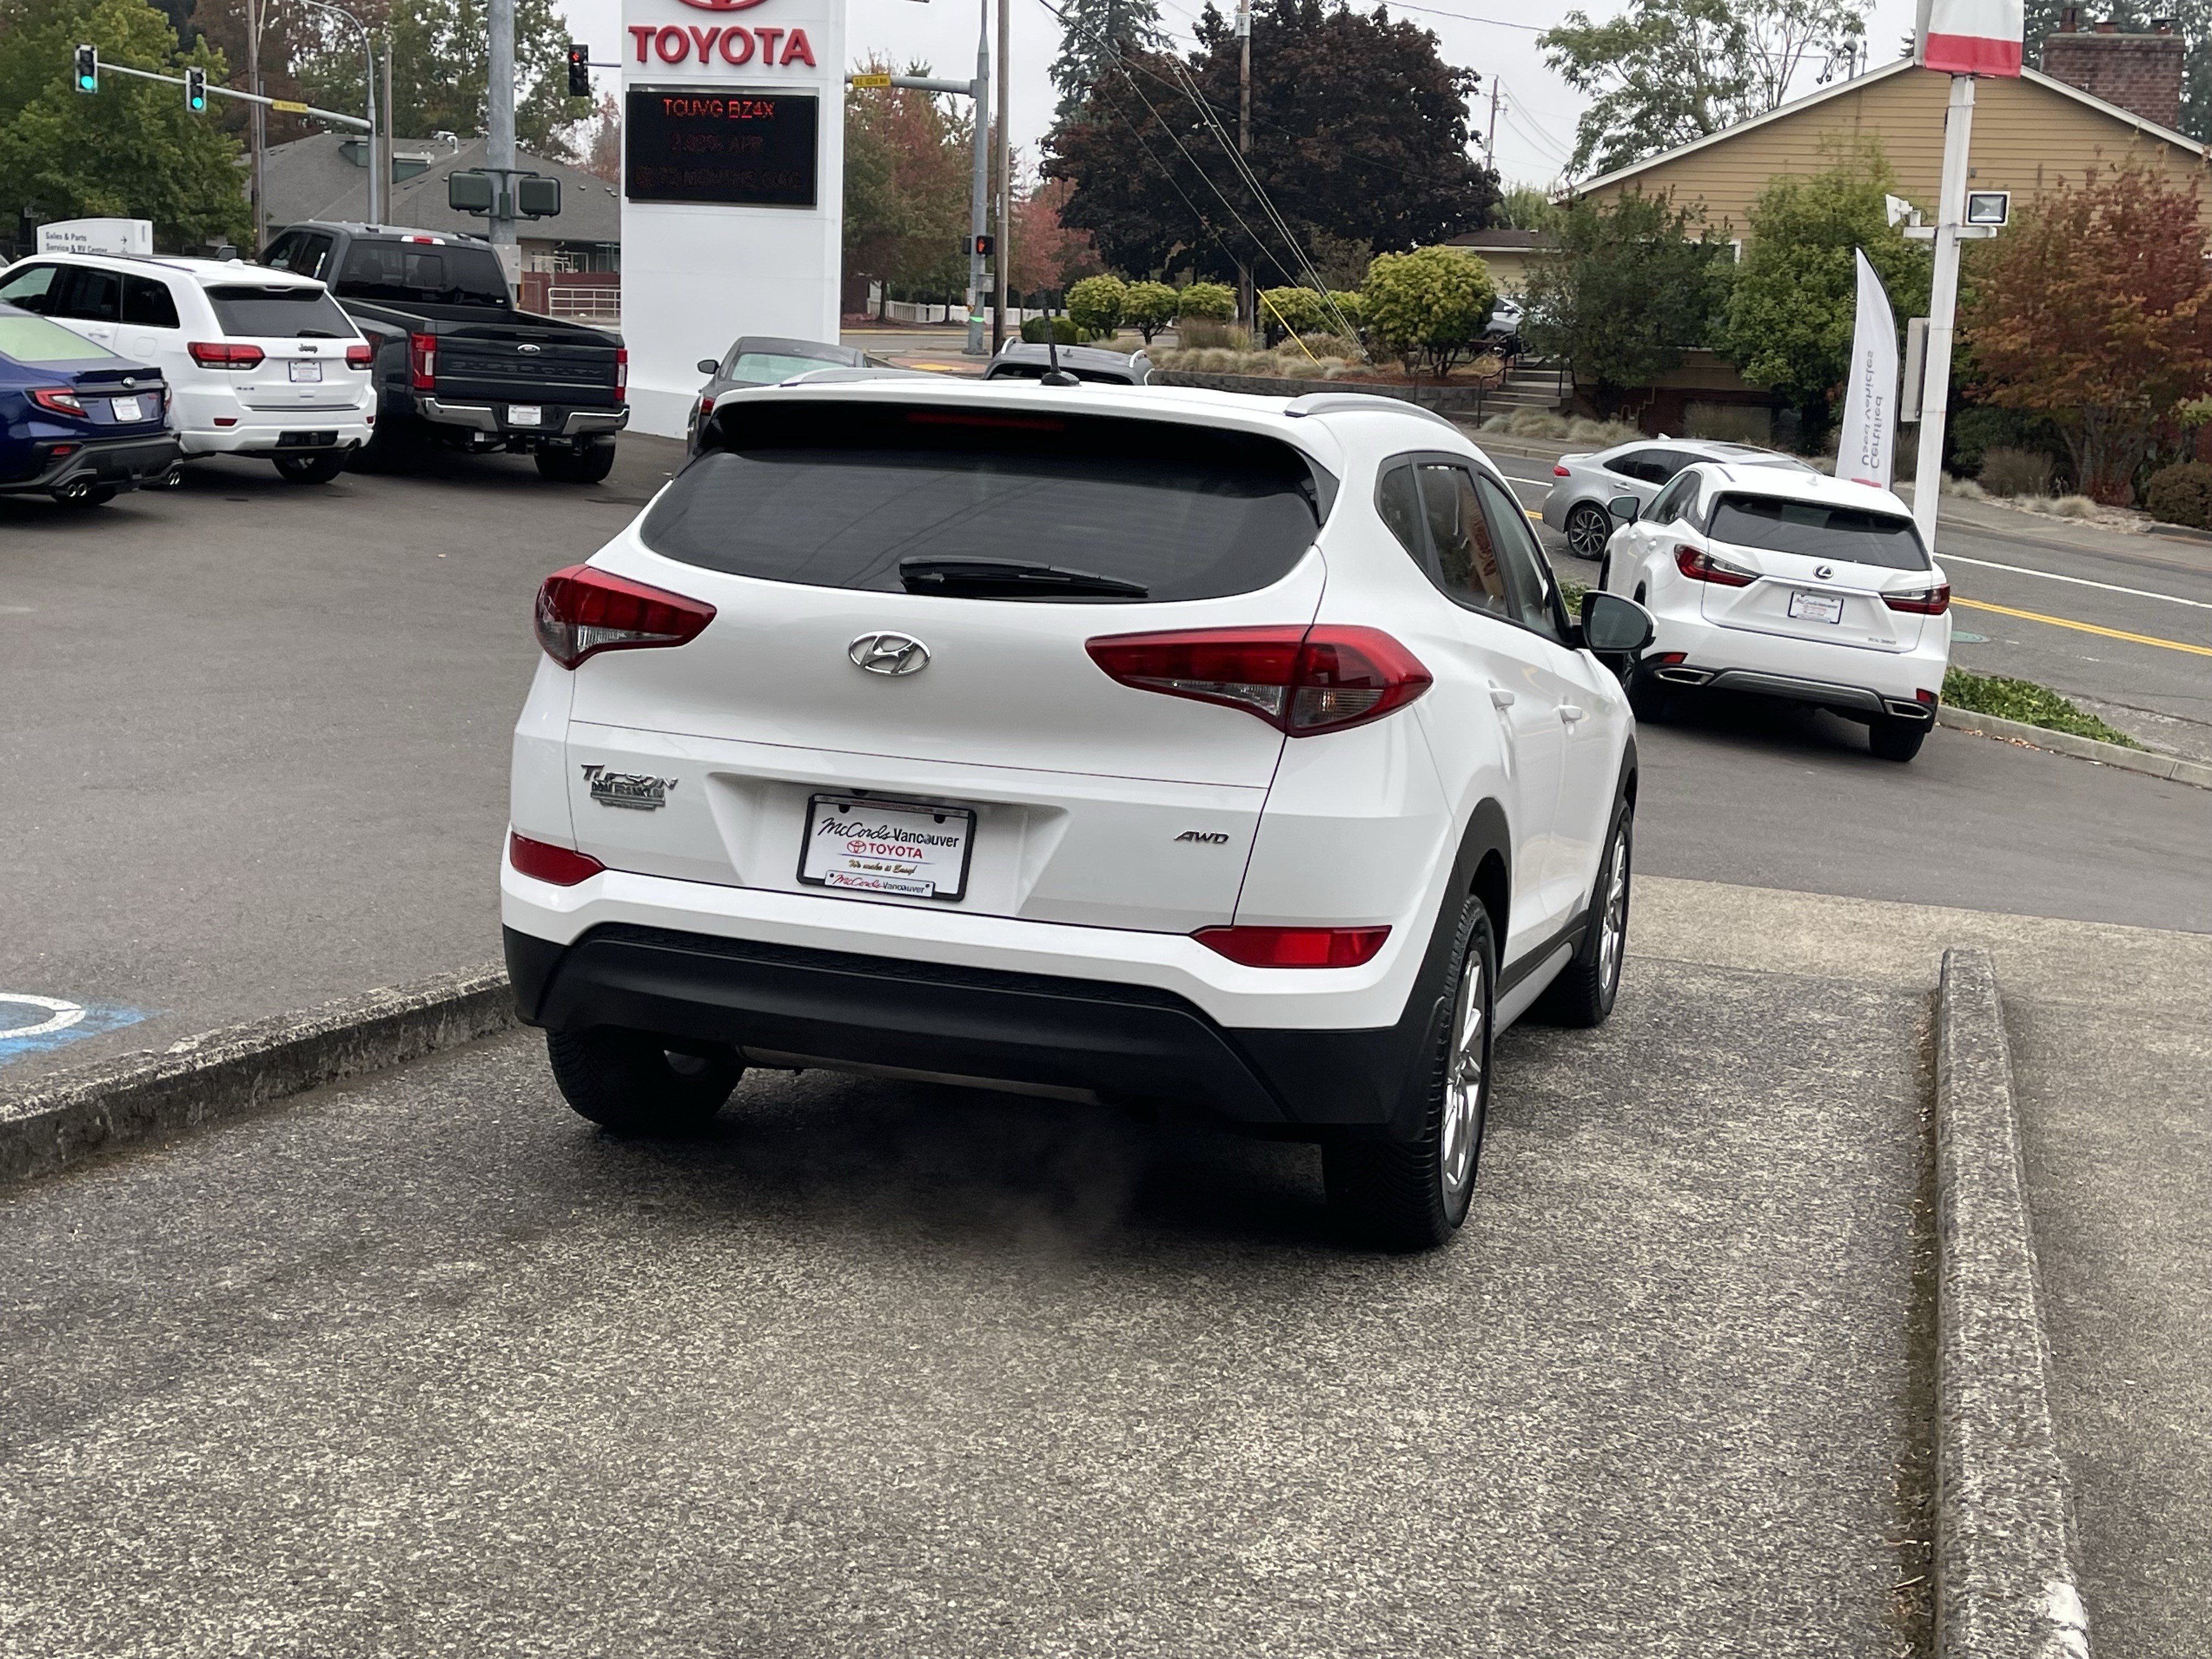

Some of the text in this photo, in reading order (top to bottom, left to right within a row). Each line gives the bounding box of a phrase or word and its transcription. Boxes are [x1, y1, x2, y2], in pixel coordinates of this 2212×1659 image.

[628, 25, 816, 67] TOYOTA
[728, 100, 776, 120] BZ4X
[46, 232, 63, 240] Sales
[71, 233, 87, 241] Parts
[46, 243, 69, 252] Service
[580, 764, 679, 790] TUCSON
[894, 828, 960, 848] Vancouver
[1173, 830, 1229, 844] AWD
[869, 843, 923, 859] TOYOTA
[882, 881, 925, 893] Vancouver
